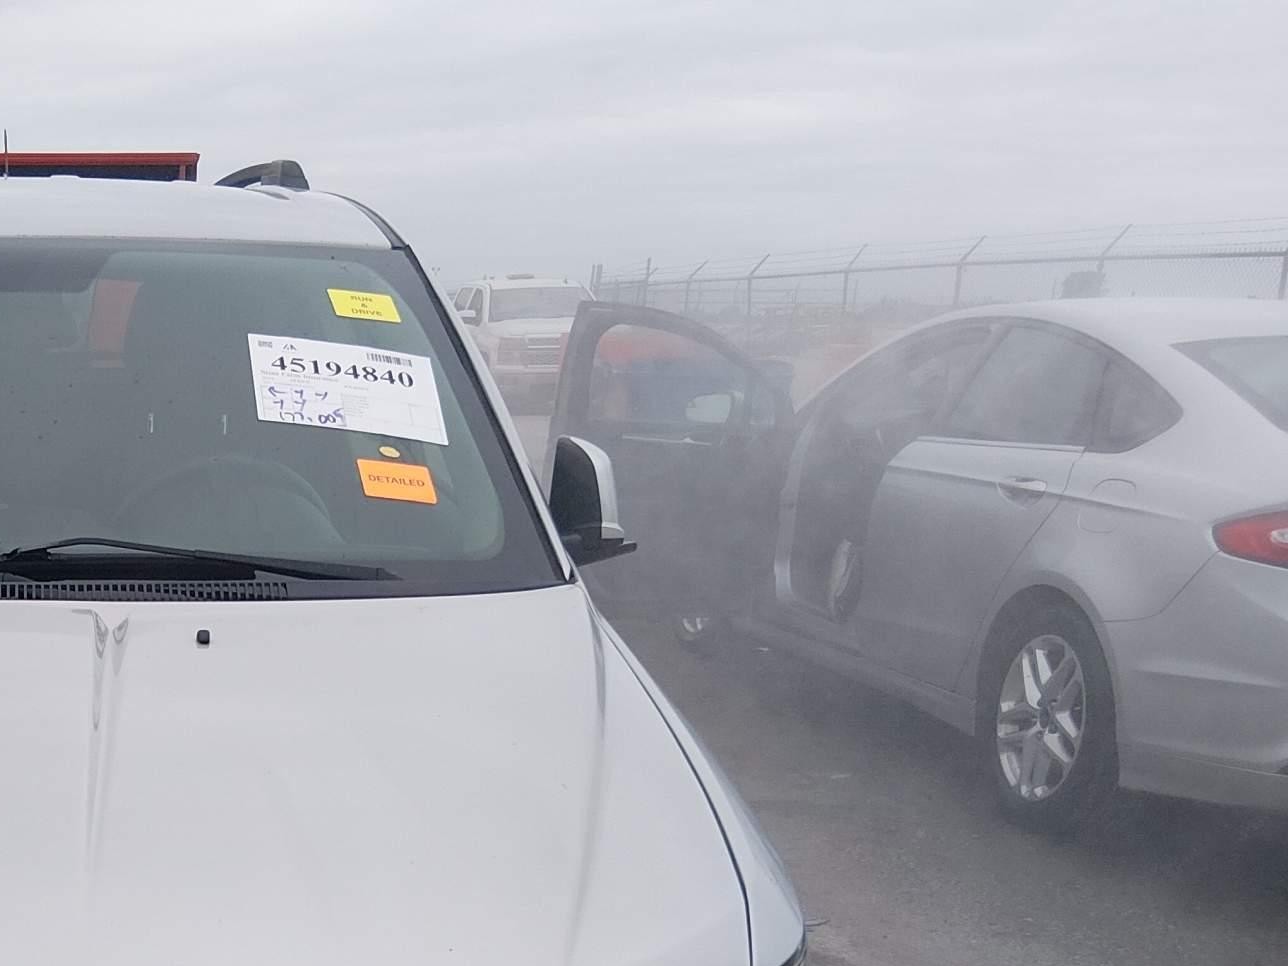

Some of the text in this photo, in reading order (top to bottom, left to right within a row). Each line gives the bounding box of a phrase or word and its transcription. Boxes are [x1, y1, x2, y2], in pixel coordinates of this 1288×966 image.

[351, 308, 383, 316] DRIVE
[272, 356, 414, 388] 45194840
[368, 474, 425, 487] DETAILED
